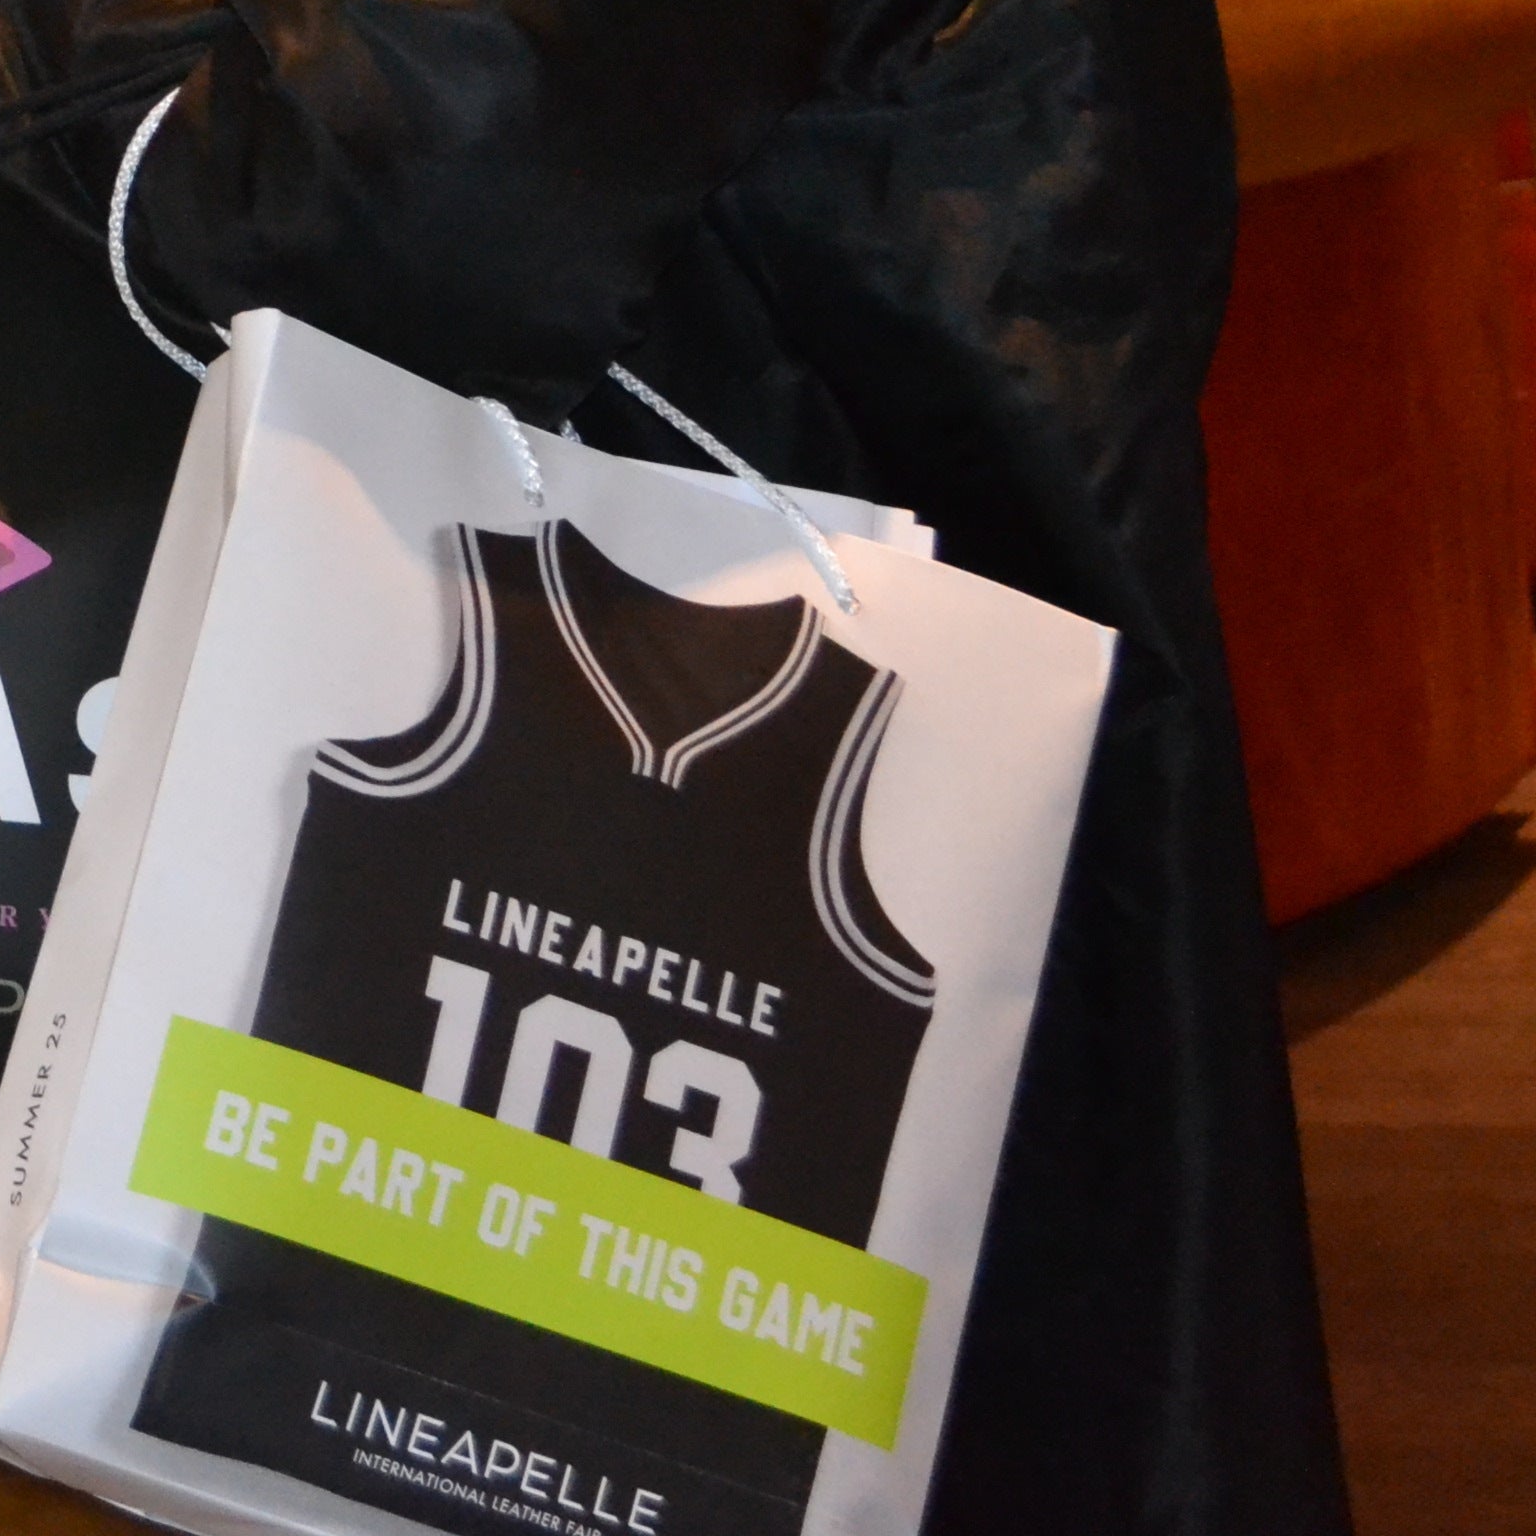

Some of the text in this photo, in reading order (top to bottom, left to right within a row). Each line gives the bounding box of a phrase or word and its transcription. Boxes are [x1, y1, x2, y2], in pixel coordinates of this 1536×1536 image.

[442, 878, 781, 1037] LINEAPELLE
[10, 1013, 66, 1207] SUMMER 25
[421, 955, 762, 1206] 103
[204, 1089, 875, 1376] BE PART OF THIS GAME
[311, 1379, 666, 1535] LINEAPELLE
[353, 1448, 486, 1507] INTERNATIONAL
[492, 1494, 560, 1532] LEATHER
